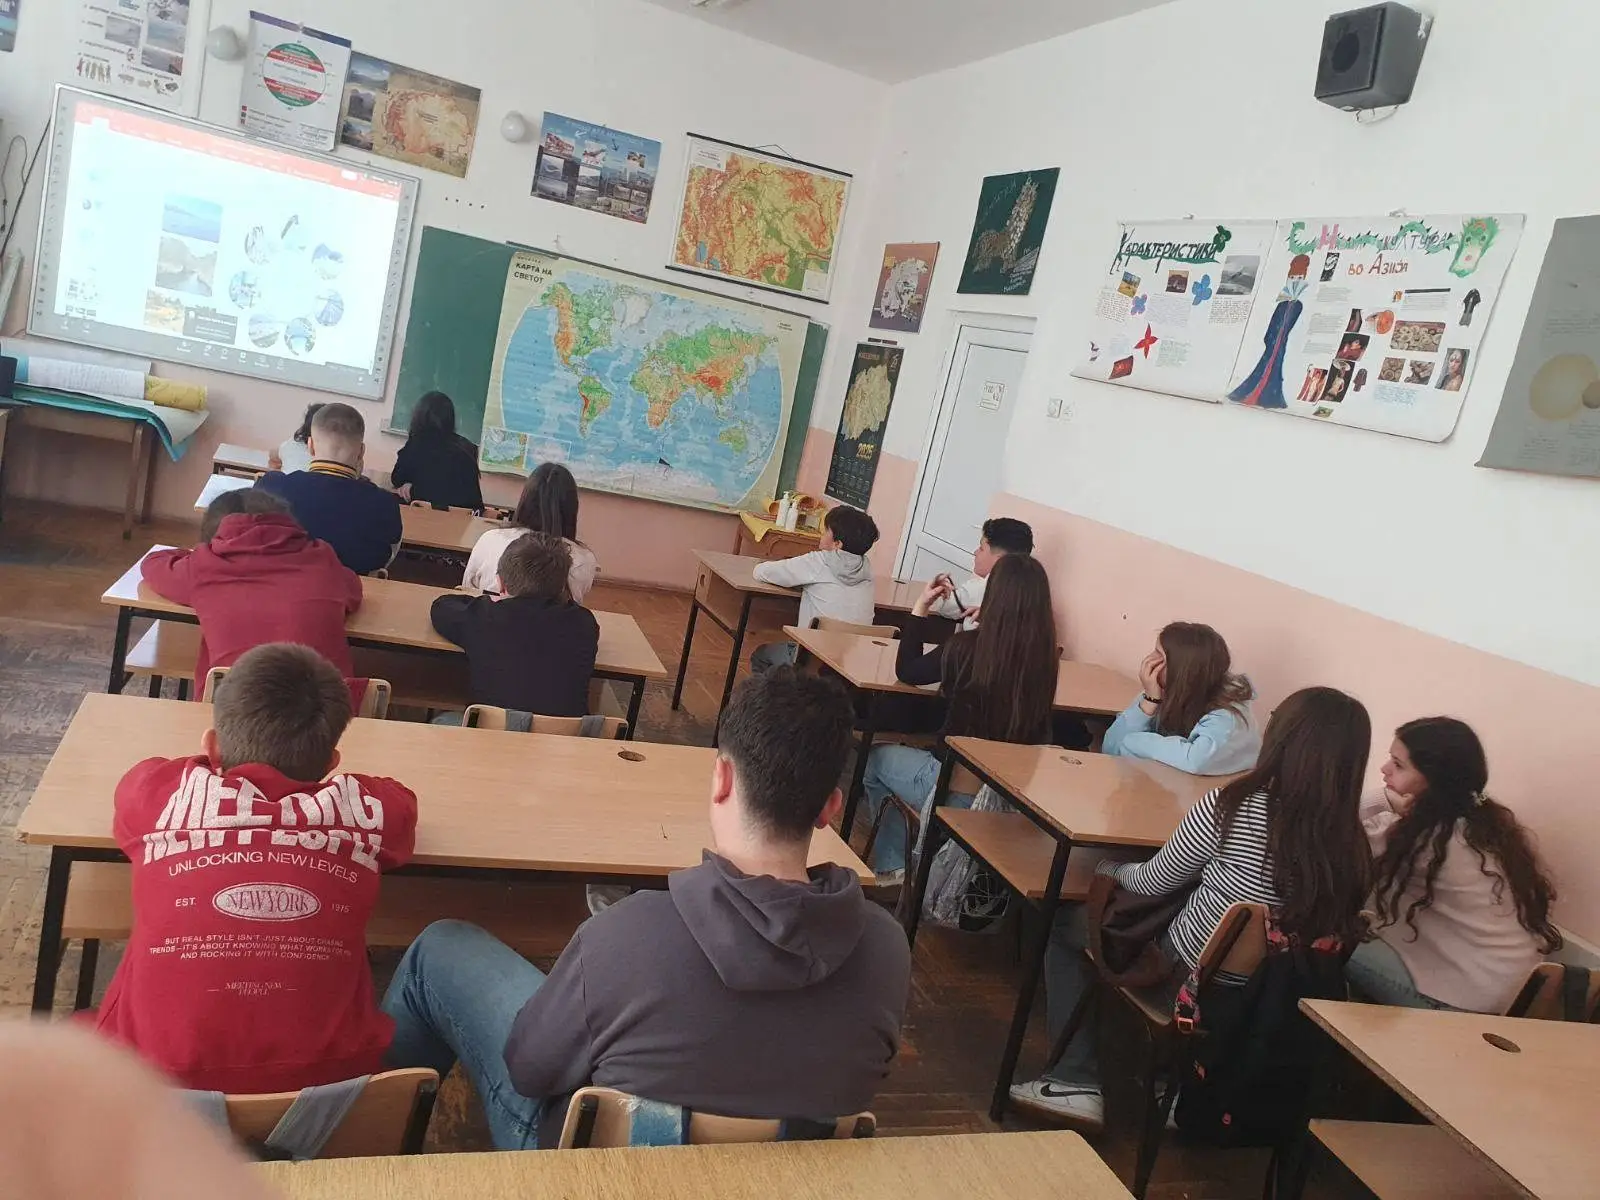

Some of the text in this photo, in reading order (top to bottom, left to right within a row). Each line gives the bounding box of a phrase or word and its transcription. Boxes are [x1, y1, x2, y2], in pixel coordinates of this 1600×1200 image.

[515, 263, 552, 275] КАРТА НА
[514, 271, 544, 284] СВЕТОТ
[168, 851, 358, 884] UNLOCKING NEW LEVELS
[175, 896, 197, 907] EST.
[165, 937, 180, 945] BUT
[182, 935, 203, 943] REAL
[206, 934, 234, 942] STYLE
[287, 936, 316, 945] ABOUT
[200, 942, 230, 950] ABOUT
[232, 942, 276, 950] KNOWING
[180, 951, 198, 960] AND
[200, 950, 241, 958] ROCKING
